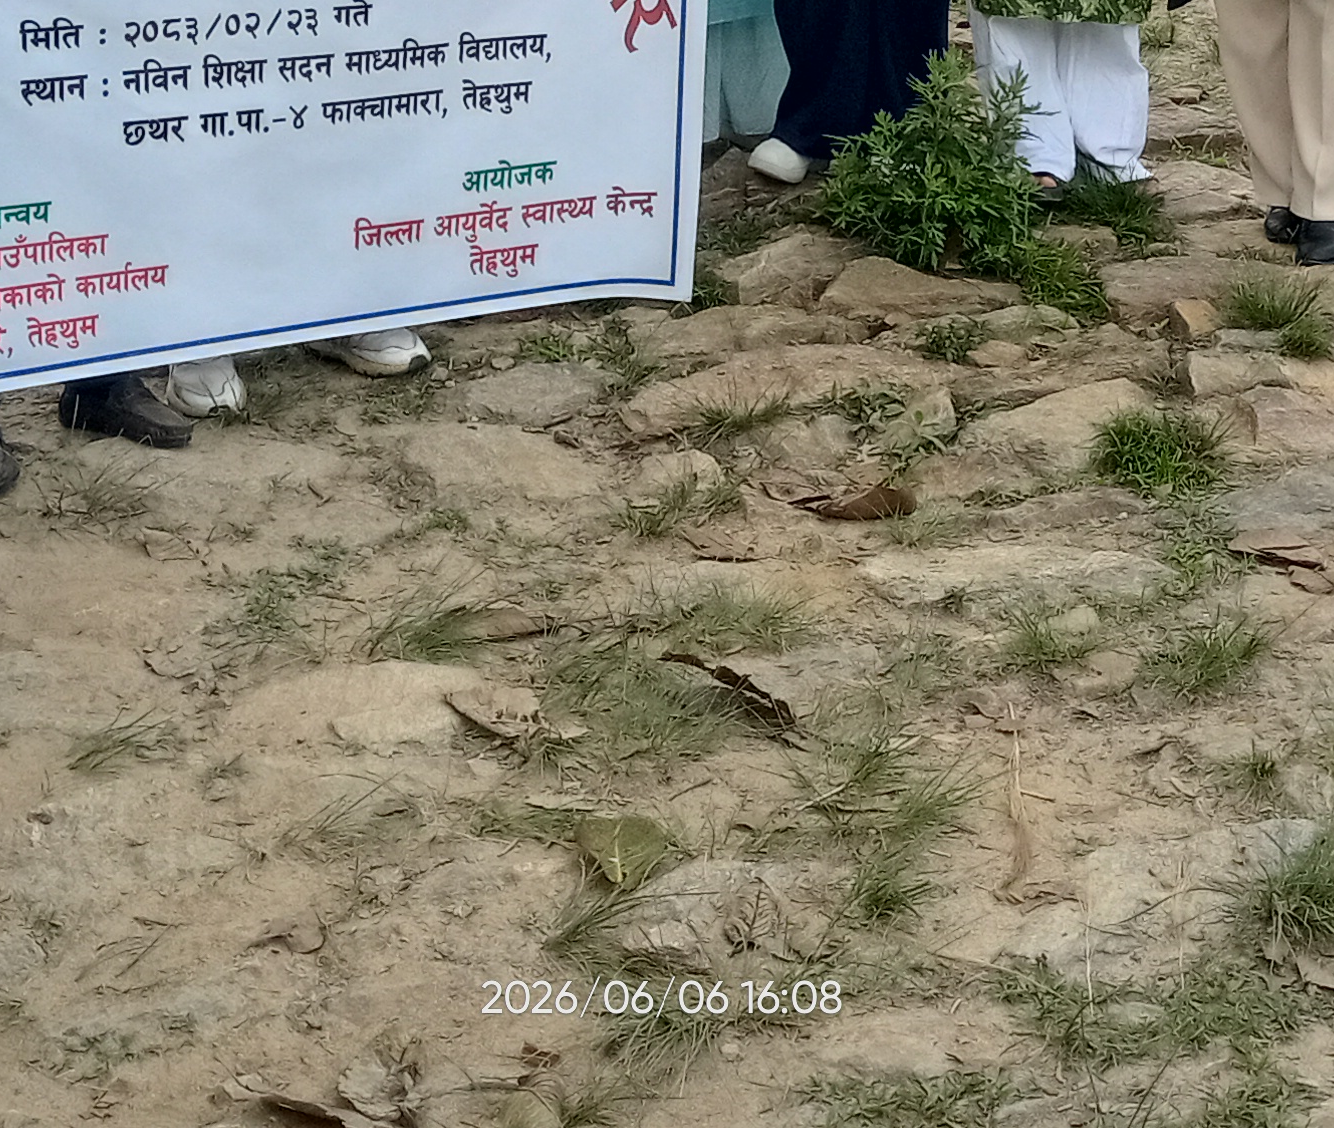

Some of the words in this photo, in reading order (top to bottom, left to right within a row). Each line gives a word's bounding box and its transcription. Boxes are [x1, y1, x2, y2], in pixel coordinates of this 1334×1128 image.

[19, 17, 85, 53] मिति
[123, 8, 319, 48] २०८३/०२/२३
[20, 74, 89, 107] स्थान
[122, 58, 192, 95] नविन
[202, 54, 268, 90] शिक्षा
[277, 53, 335, 83] सदन
[344, 38, 450, 76] माध्यमिक
[458, 31, 552, 65] विद्यालय,
[321, 88, 448, 125] फाक्चामारा,
[462, 79, 533, 114] तेह्रथुम
[461, 159, 558, 193] आयोजक
[353, 217, 425, 251] जिल्ला
[433, 200, 513, 244] आयुर्वेद
[521, 195, 597, 229] स्वास्थ्य
[605, 186, 658, 219] केन्द्र
[75, 261, 169, 299] कार्यालय
[469, 243, 539, 278] तेह्रथुम
[26, 313, 100, 350] तेह्रथुम
